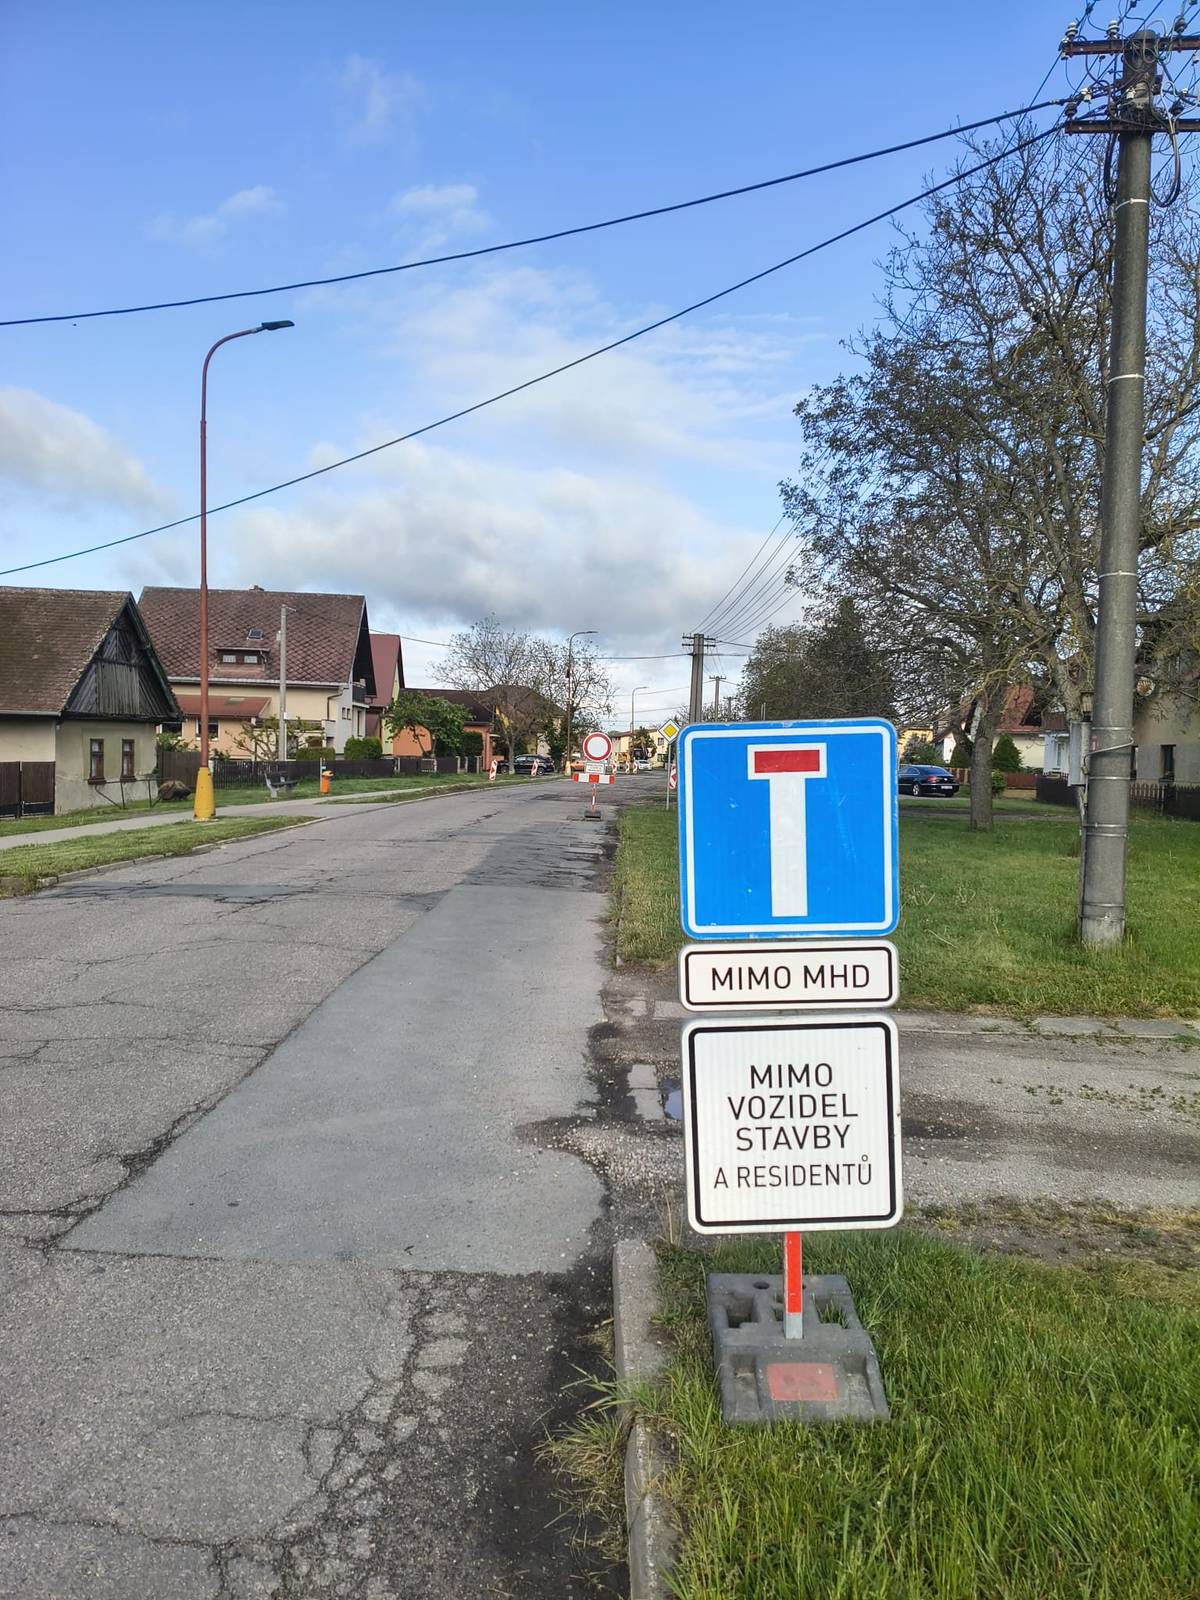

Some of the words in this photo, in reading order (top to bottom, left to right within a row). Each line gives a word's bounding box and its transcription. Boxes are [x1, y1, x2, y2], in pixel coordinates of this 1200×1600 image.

[711, 966, 791, 991] MIMO
[803, 964, 870, 989] MHD
[750, 1062, 833, 1090] MIMO
[727, 1093, 859, 1121] VOZIDEL
[736, 1124, 850, 1152] STAVBY
[713, 1167, 729, 1189] A
[737, 1154, 872, 1188] RESIDENTŮ
